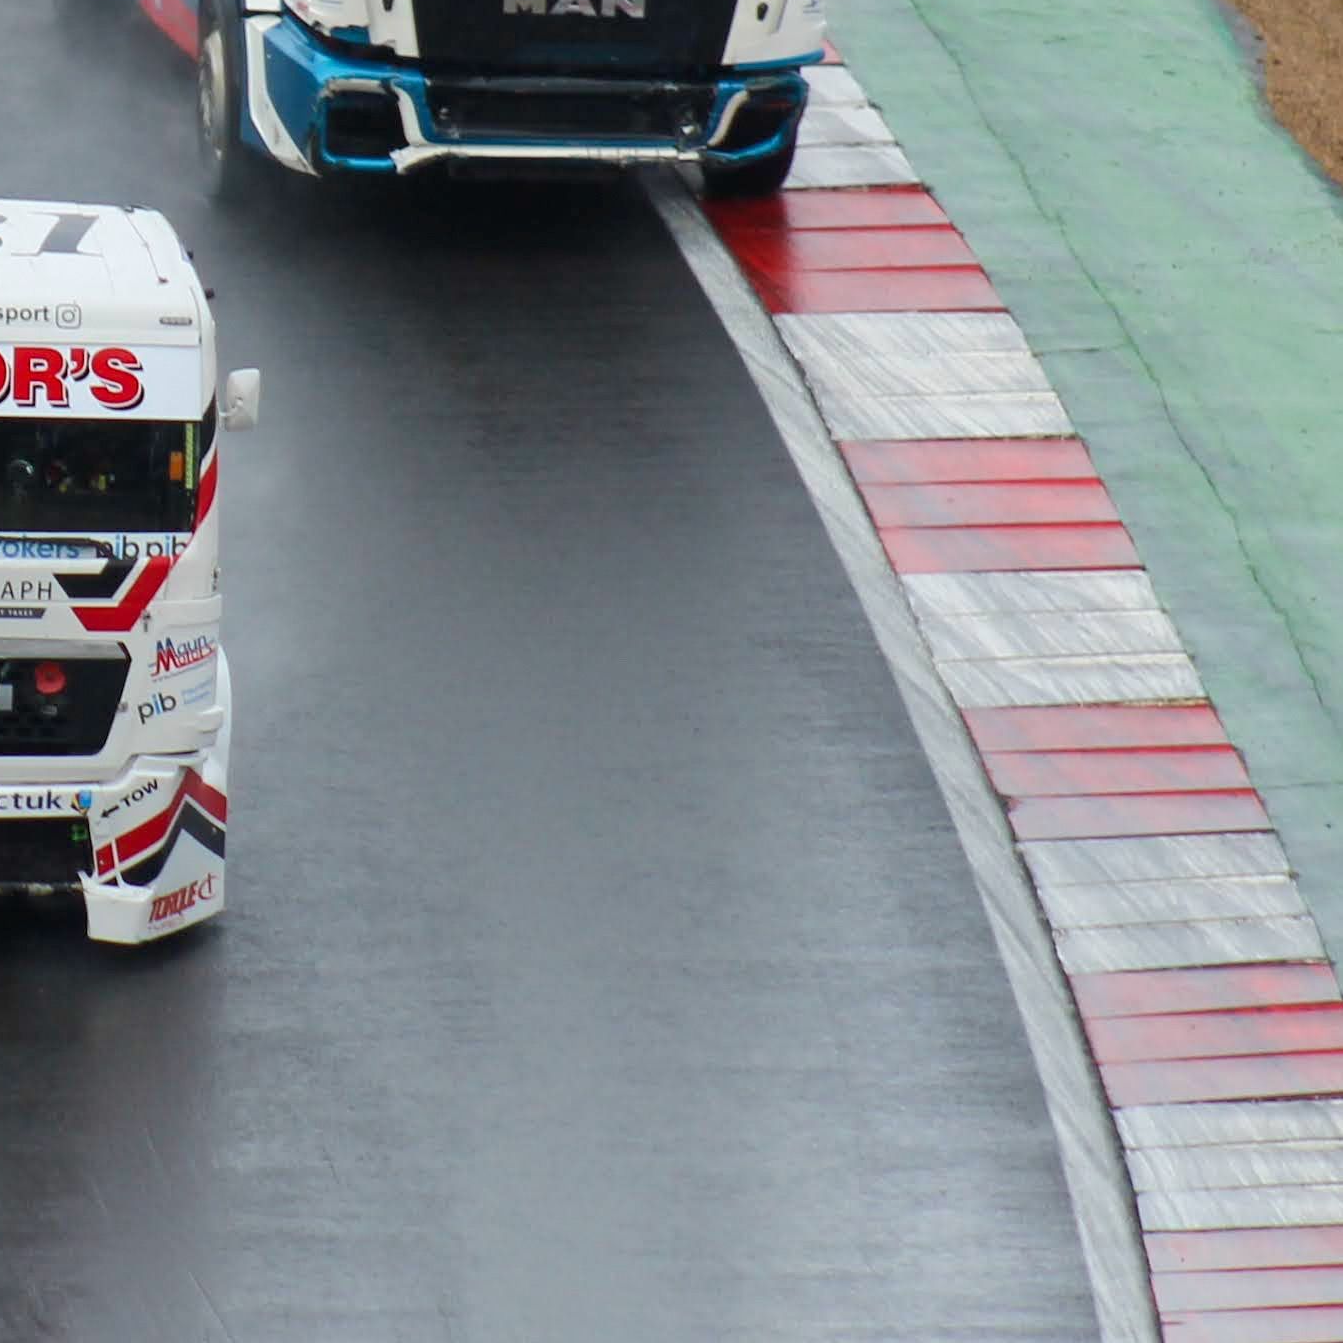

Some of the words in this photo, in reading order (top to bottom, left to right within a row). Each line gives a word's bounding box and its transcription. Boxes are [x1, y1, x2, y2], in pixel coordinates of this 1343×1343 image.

[146, 535, 188, 560] pib
[137, 692, 177, 725] pib
[120, 778, 159, 807] TOW
